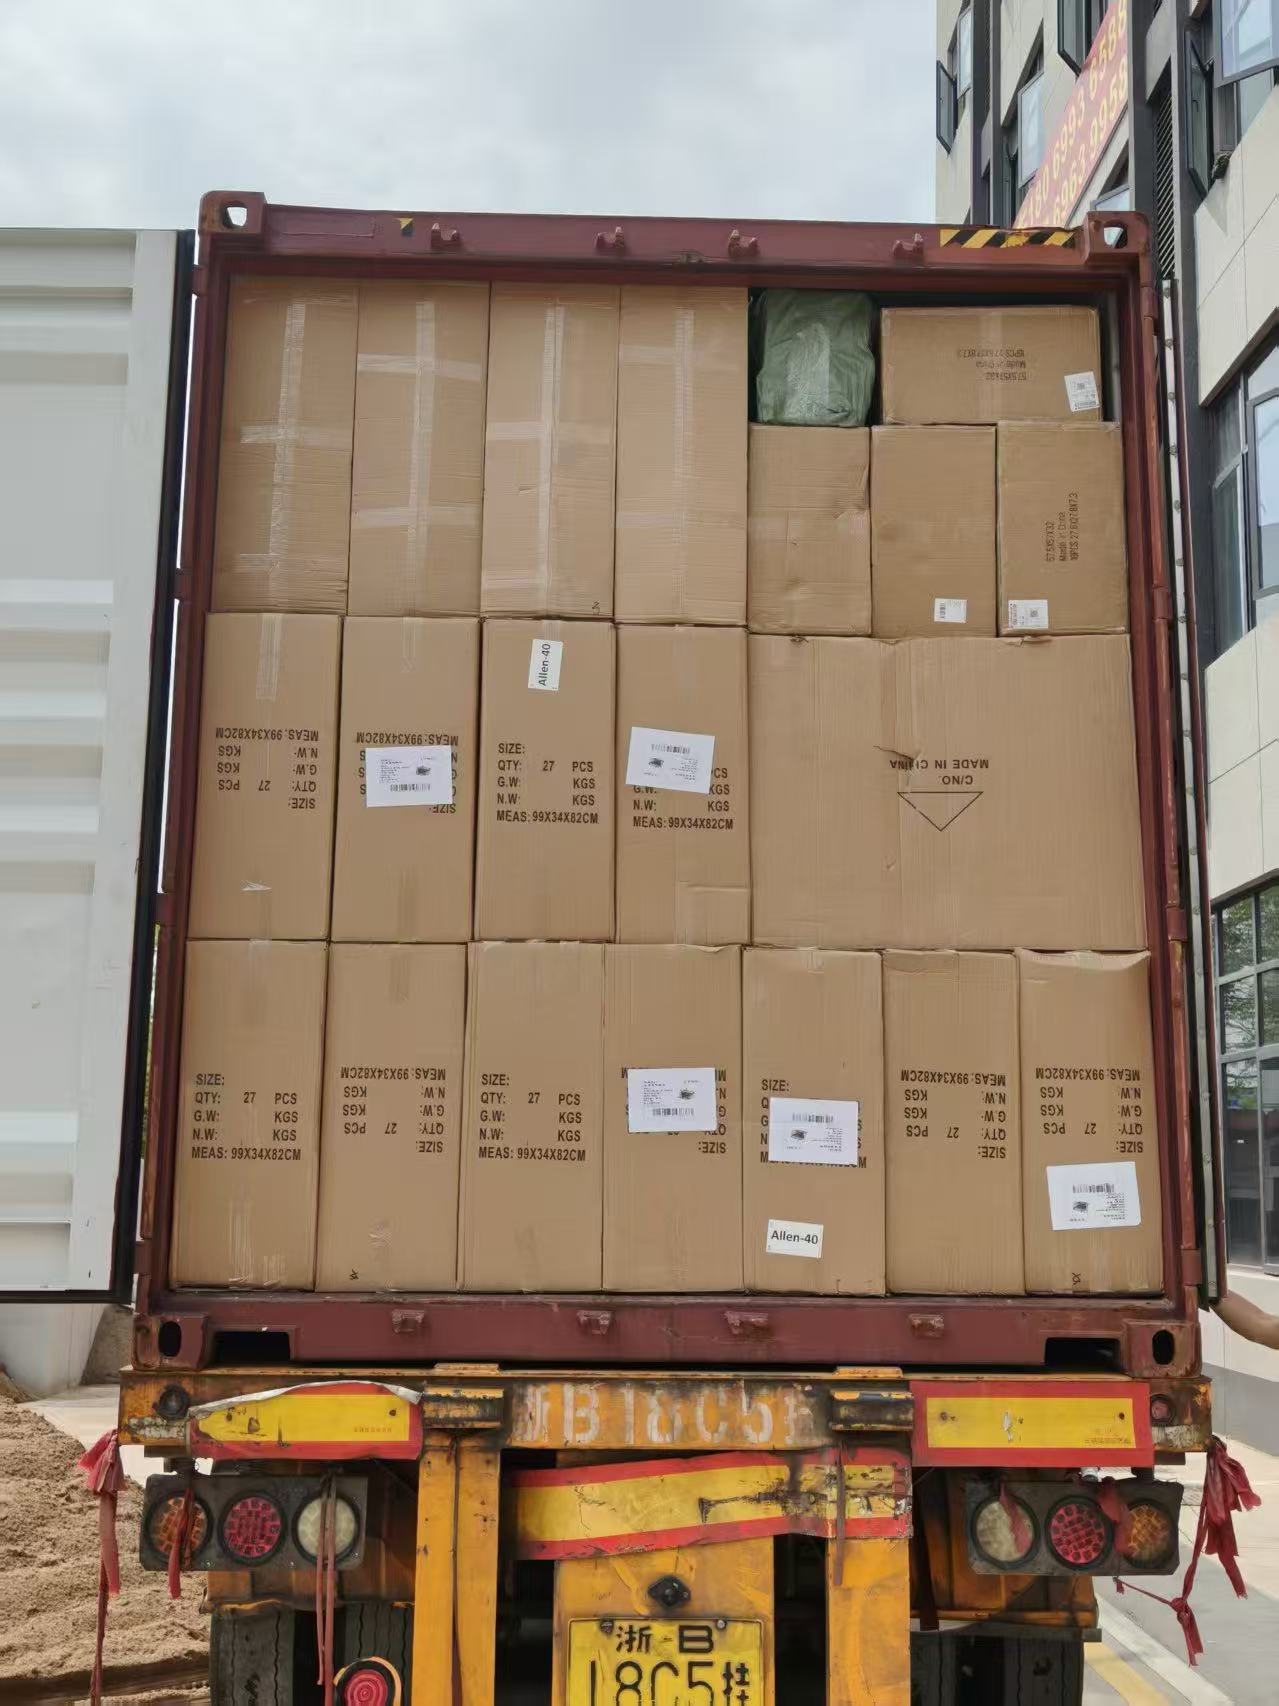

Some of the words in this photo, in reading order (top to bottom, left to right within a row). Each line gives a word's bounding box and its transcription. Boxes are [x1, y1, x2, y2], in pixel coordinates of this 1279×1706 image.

[538, 642, 551, 686] Allen-40
[218, 745, 241, 757] KGS
[498, 743, 526, 754] SIZE:
[217, 762, 240, 774] KGS
[498, 760, 522, 771] QTY:
[542, 760, 555, 772] 27
[571, 761, 594, 772] PCS
[934, 759, 947, 769] IN
[952, 759, 990, 769] MADE
[711, 767, 728, 779] CS
[218, 779, 240, 791] PCS
[258, 780, 271, 792] 27
[292, 781, 317, 793] QTY:
[497, 776, 521, 788] G.W:
[573, 778, 596, 790] KGS
[709, 784, 730, 796] KGS
[288, 797, 316, 810] SIZE:
[497, 793, 521, 805] N.W:
[572, 794, 595, 806] KGS
[633, 800, 657, 811] N.W:
[708, 800, 730, 812] KGS
[196, 1073, 225, 1086] SIZE:
[481, 1073, 510, 1086] SIZE:
[761, 1079, 790, 1092] SIZE:
[195, 1091, 221, 1104] QTY:
[243, 1091, 257, 1104] 27
[274, 1092, 298, 1105] PCS
[343, 1086, 367, 1098] KGS
[420, 1086, 446, 1099] N.W:
[480, 1091, 506, 1104] QTY:
[527, 1092, 541, 1104] 27
[558, 1093, 581, 1106] PCS
[904, 1089, 928, 1102] KGS
[981, 1091, 1006, 1105] N.W:
[1040, 1086, 1064, 1099] KGS
[193, 1110, 220, 1122] G.W:
[274, 1111, 299, 1123] KGS
[342, 1104, 366, 1116] KGS
[420, 1104, 445, 1117] G.W:
[903, 1106, 928, 1119] KGS
[1040, 1104, 1064, 1117] KGS
[1117, 1105, 1142, 1117] G.W:
[480, 1110, 505, 1122] G.W:
[559, 1111, 582, 1124] KGS
[192, 1128, 218, 1141] N.W:
[272, 1129, 297, 1141] KGS
[344, 1122, 367, 1134] PCS
[384, 1122, 397, 1135] 27
[419, 1122, 444, 1135] QTY:
[479, 1127, 504, 1141] N.W:
[557, 1129, 581, 1142] KGS
[906, 1125, 929, 1138] PCS
[946, 1126, 959, 1139] 27
[981, 1127, 1006, 1141] QTY:
[1043, 1122, 1066, 1135] PCS
[1084, 1123, 1097, 1135] 27
[1118, 1122, 1143, 1136] QTY:
[415, 1141, 444, 1153] SIZE:
[697, 1141, 727, 1154] SIZE:
[977, 1146, 1006, 1159] SIZE:
[1115, 1140, 1144, 1153] SIZE:
[770, 1229, 819, 1245] Allen-40
